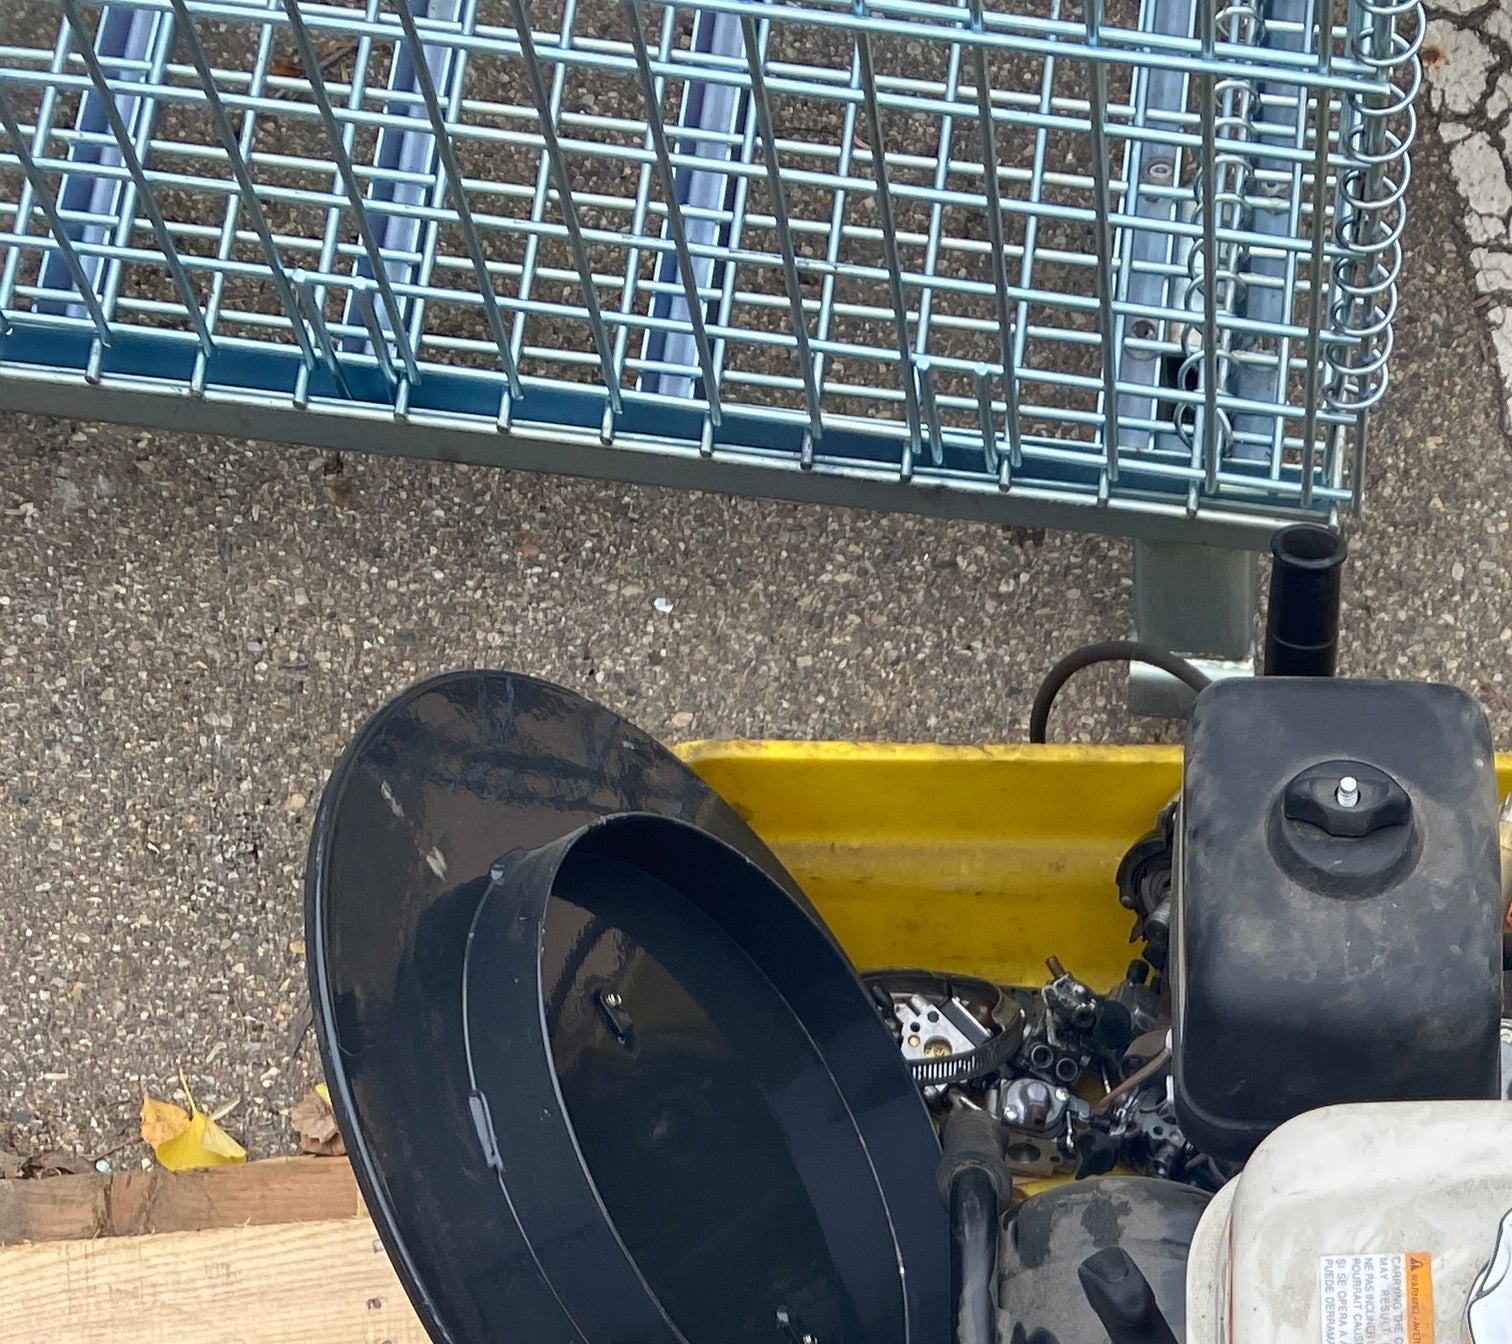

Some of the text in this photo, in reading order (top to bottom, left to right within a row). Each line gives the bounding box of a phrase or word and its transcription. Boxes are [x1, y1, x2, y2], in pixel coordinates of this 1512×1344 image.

[1323, 1258, 1333, 1292] PUEDE
[1336, 1258, 1345, 1268] SI
[1364, 1257, 1373, 1270] NE
[1379, 1257, 1388, 1280] MAY
[1336, 1272, 1346, 1286] SE
[1351, 1258, 1361, 1309] POURRAIT
[1364, 1273, 1373, 1291] PAS
[1391, 1256, 1402, 1309] CARRYING
[1337, 1290, 1347, 1326] OPERA
[1365, 1294, 1375, 1338] INCLINER
[1380, 1289, 1390, 1331] RESULT
[1392, 1313, 1402, 1333] THE
